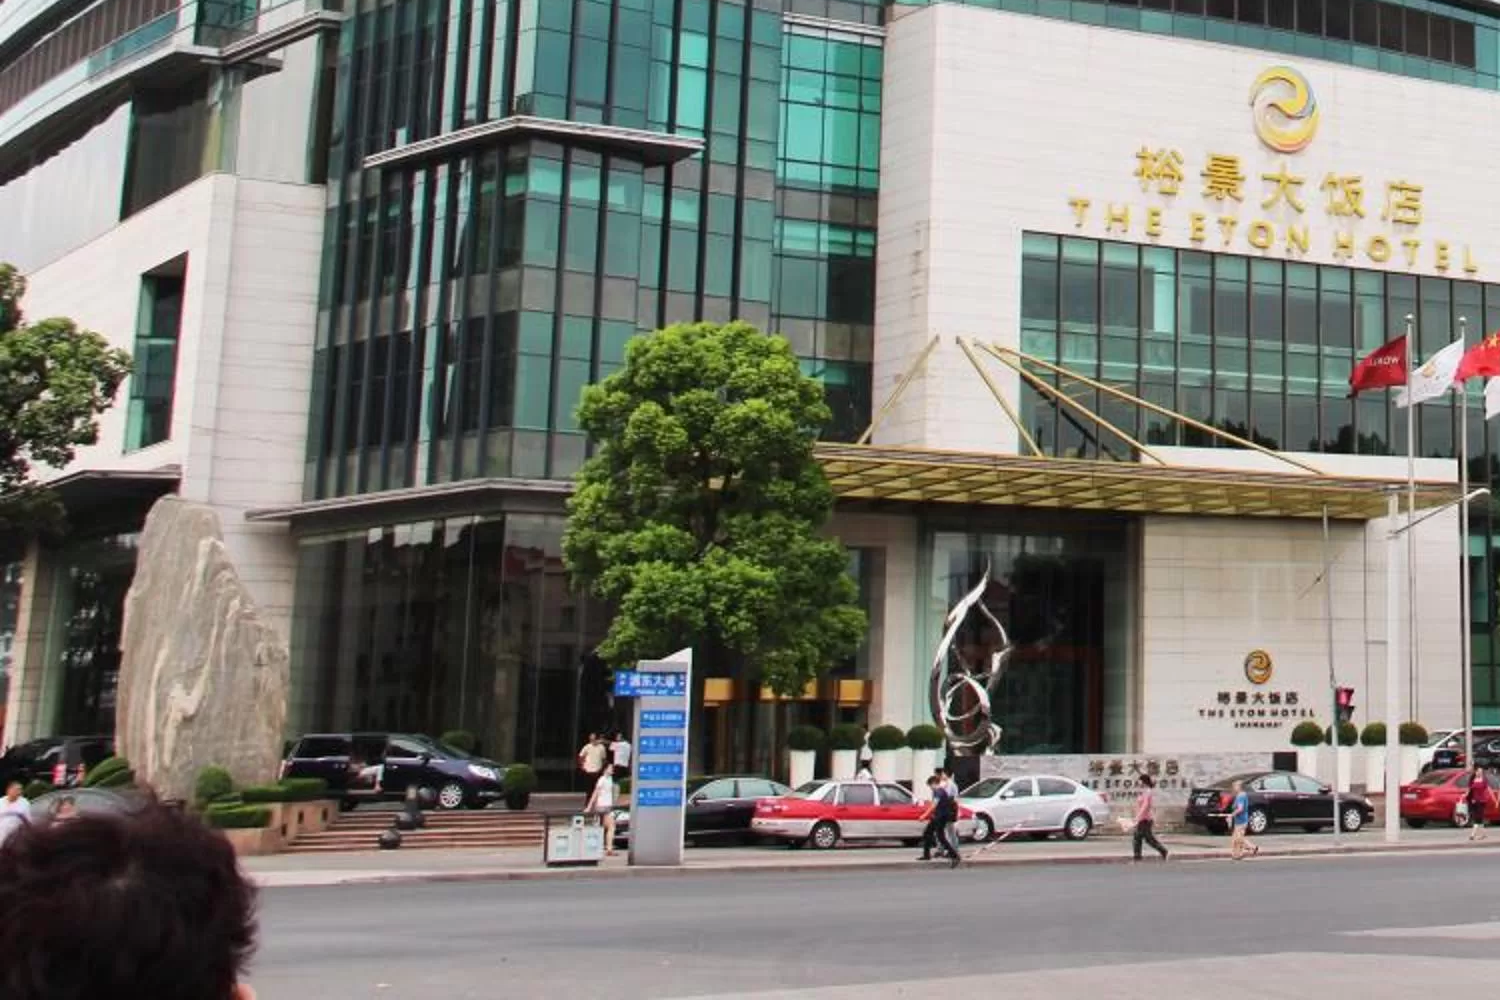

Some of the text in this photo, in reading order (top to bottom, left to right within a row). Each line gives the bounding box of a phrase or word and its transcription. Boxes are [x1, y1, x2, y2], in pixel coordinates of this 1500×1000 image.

[1134, 145, 1425, 226] 裕景大饭店
[1068, 198, 1479, 274] THE ETON HOTEL
